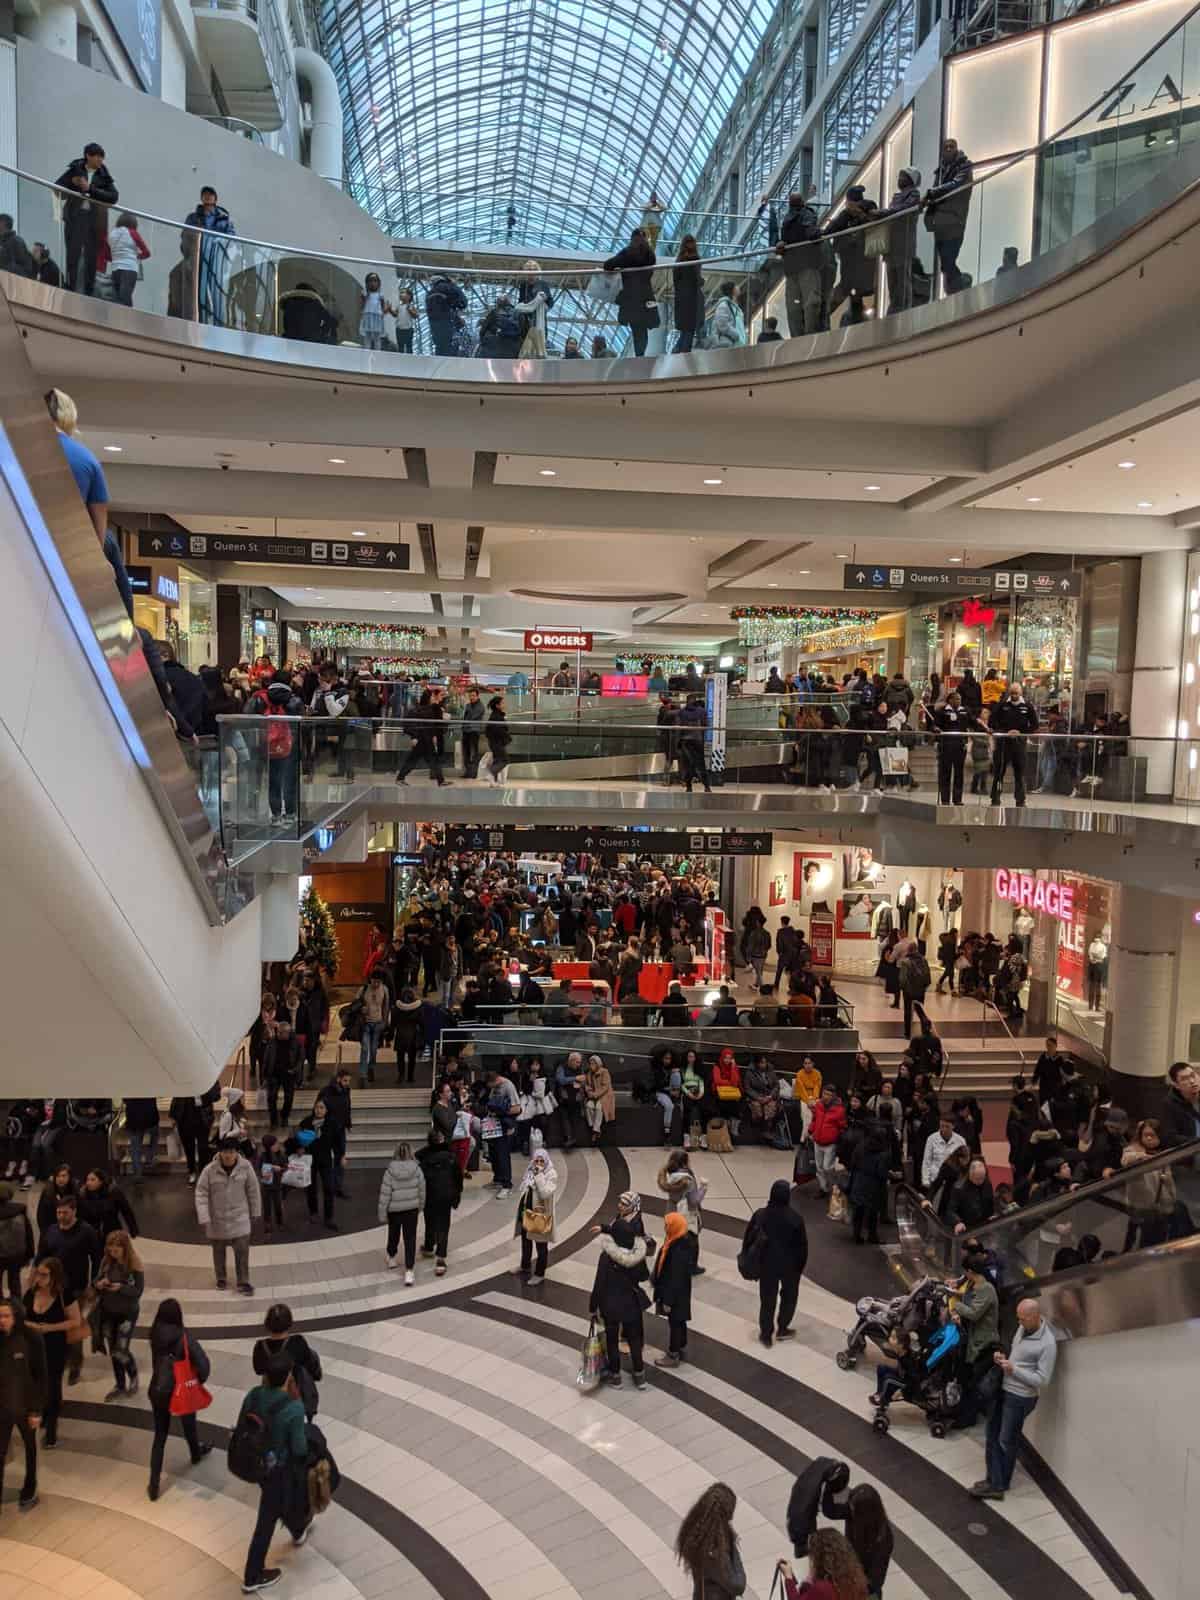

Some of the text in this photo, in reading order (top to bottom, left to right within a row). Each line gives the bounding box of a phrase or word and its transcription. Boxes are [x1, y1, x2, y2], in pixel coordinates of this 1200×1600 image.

[1096, 73, 1200, 122] ZA
[213, 540, 246, 552] Queen
[247, 542, 258, 552] St
[910, 572, 939, 584] Queen
[940, 573, 950, 584] St
[543, 635, 587, 646] ROGERS
[599, 838, 641, 848] Queen St
[995, 868, 1074, 921] GARAGE
[1058, 921, 1085, 955] ALE
